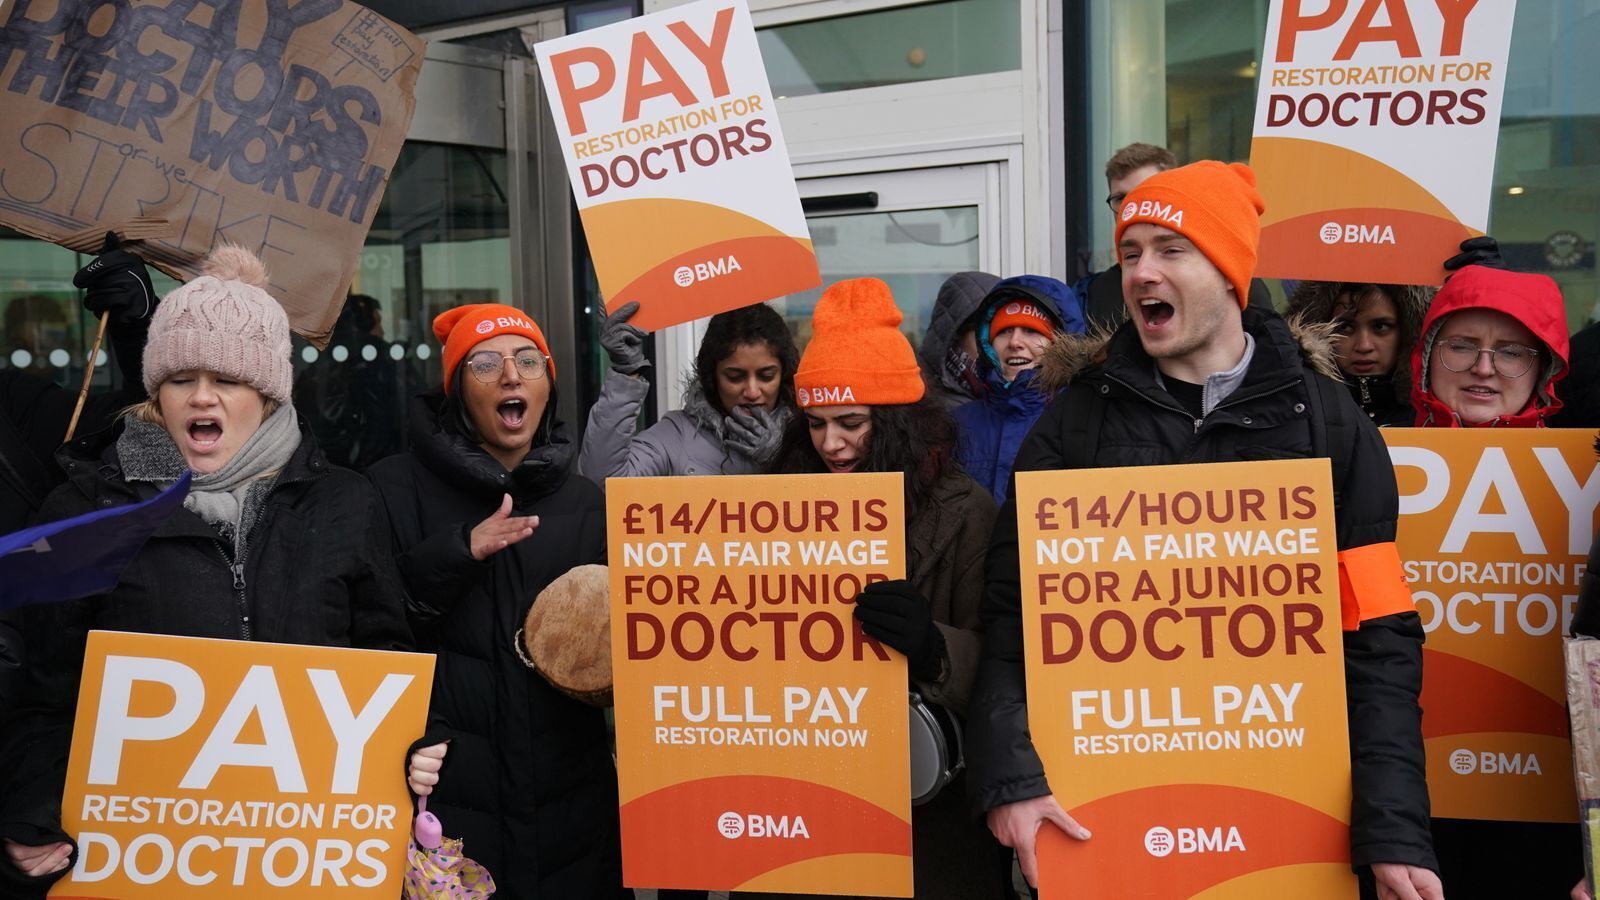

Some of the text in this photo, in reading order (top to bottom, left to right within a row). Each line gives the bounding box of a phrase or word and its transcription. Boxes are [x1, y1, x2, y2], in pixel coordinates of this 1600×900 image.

[351, 26, 375, 50] pay
[1275, 0, 1481, 63] PAY
[549, 7, 735, 136] PAY
[1272, 62, 1492, 87] RESTORATION FOR
[573, 95, 763, 159] RESTORATION FOR
[1266, 88, 1488, 128] DOCTORS
[118, 143, 187, 180] or we
[189, 100, 386, 224] WORTH
[580, 118, 772, 198] DOCTORS
[1, 122, 306, 293] STRIKE
[1138, 200, 1184, 228] BMA
[1343, 224, 1396, 245] BMA
[694, 255, 742, 281] BMA
[497, 316, 534, 332] BMA
[812, 386, 856, 403] BMA
[623, 497, 888, 535] £14/HOUR IS
[1035, 486, 1317, 531] £14/HOUR IS
[1387, 446, 1600, 556] PAY
[623, 539, 889, 567] NOT A FAIR WAGE
[1036, 528, 1320, 565] NOT A FAIR WAGE
[624, 573, 888, 611] FOR A JUNIO
[1038, 562, 1322, 607] FOR A JUNIOR
[1403, 560, 1565, 586] STORATION
[1411, 590, 1580, 637] OCTO
[1040, 602, 1327, 665] DOCTOR
[653, 685, 868, 724] FULL PAY
[1071, 682, 1304, 730] FULL PAY
[86, 655, 416, 794] PAY
[655, 726, 868, 747] RESTORATION NOW
[1073, 727, 1304, 756] RESTORATION NOW
[1480, 752, 1542, 775] BMA
[81, 795, 397, 830] RESTORATION FOR
[748, 814, 810, 839] BMA
[1177, 826, 1246, 854] BMA
[71, 832, 391, 888] DOCTORS
